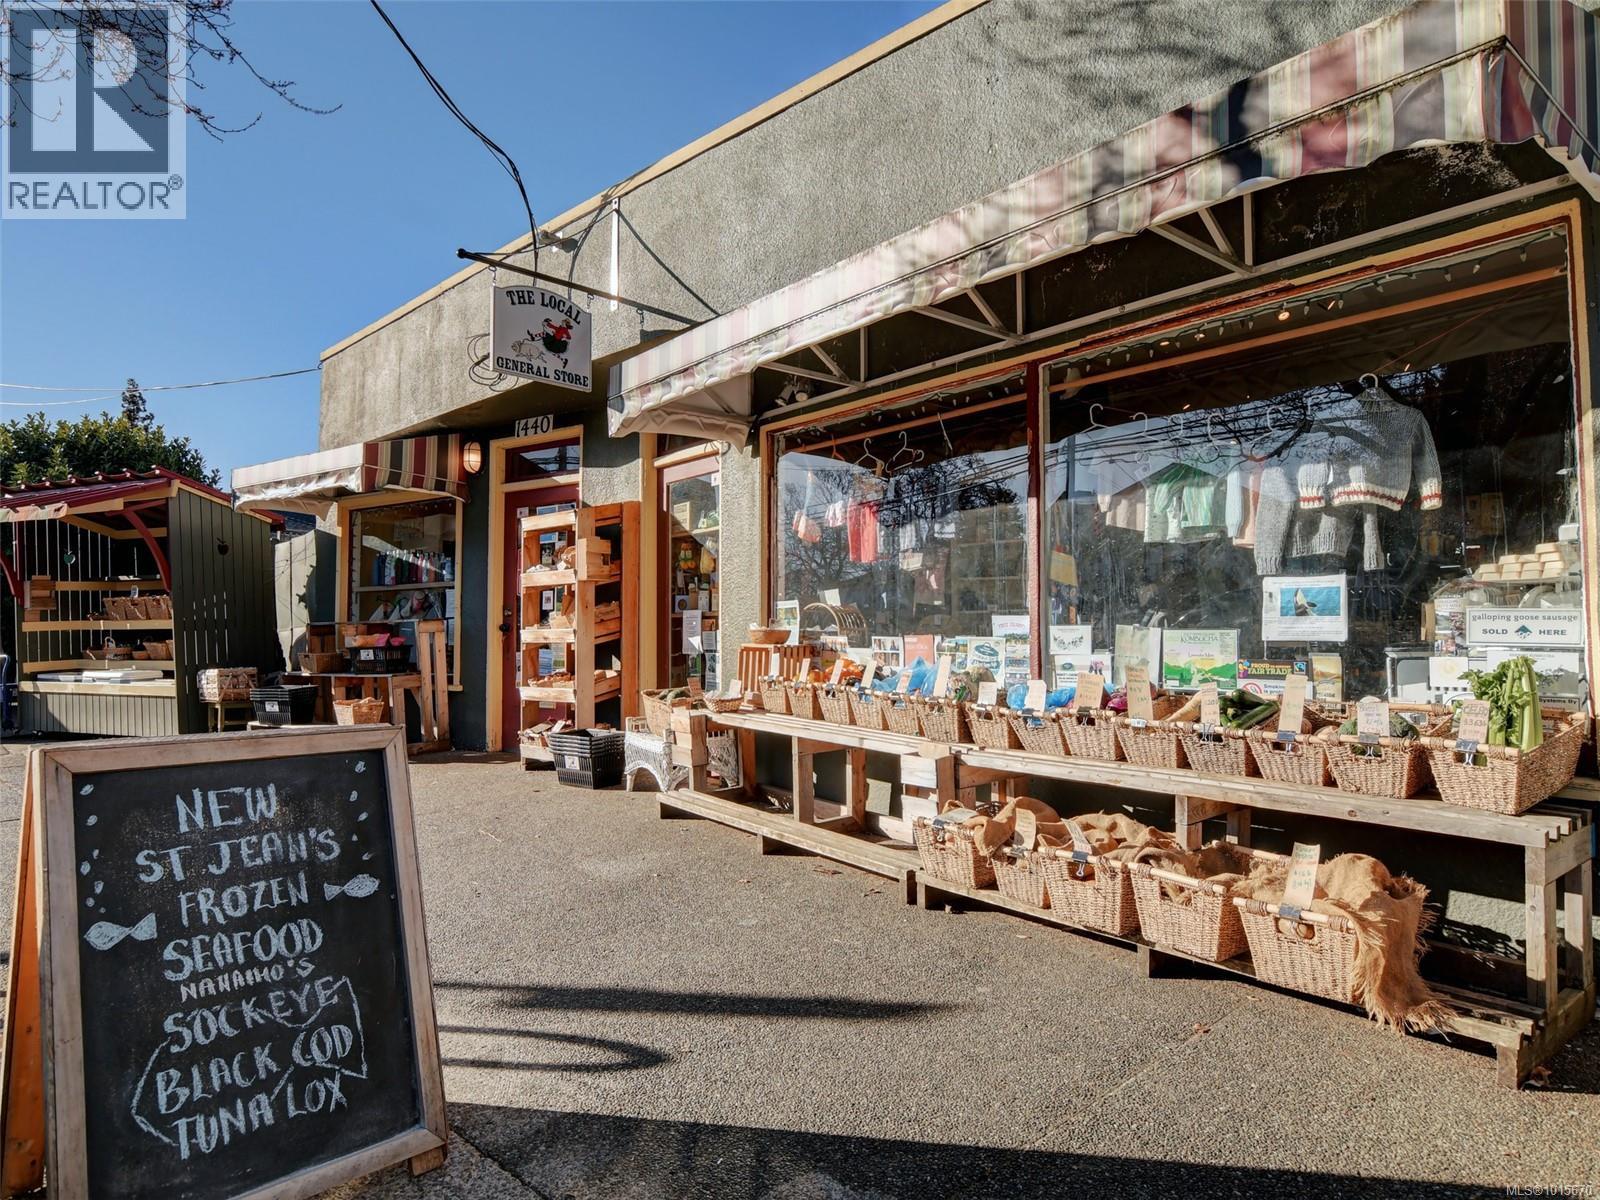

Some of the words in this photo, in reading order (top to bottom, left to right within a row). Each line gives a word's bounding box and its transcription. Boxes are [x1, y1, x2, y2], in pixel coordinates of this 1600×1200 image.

[506, 289, 536, 306] THE
[539, 292, 582, 325] LOCAL
[496, 356, 550, 379] GENERAL
[553, 368, 589, 388] STORE
[515, 415, 551, 438] 1440
[1471, 613, 1512, 622] galloping
[1512, 614, 1540, 622] goose
[1538, 628, 1568, 636] HERE
[176, 783, 278, 833] NEW
[135, 845, 191, 883] ST
[207, 827, 341, 875] JEAN'S
[179, 870, 310, 928] FROZEN
[162, 918, 323, 981] SEAFOOD
[163, 976, 339, 1054] SOCKEYE
[155, 1042, 281, 1115] BLACK
[291, 1023, 354, 1067] COD
[172, 1087, 275, 1160] TUNA
[287, 1069, 348, 1118] LOX
